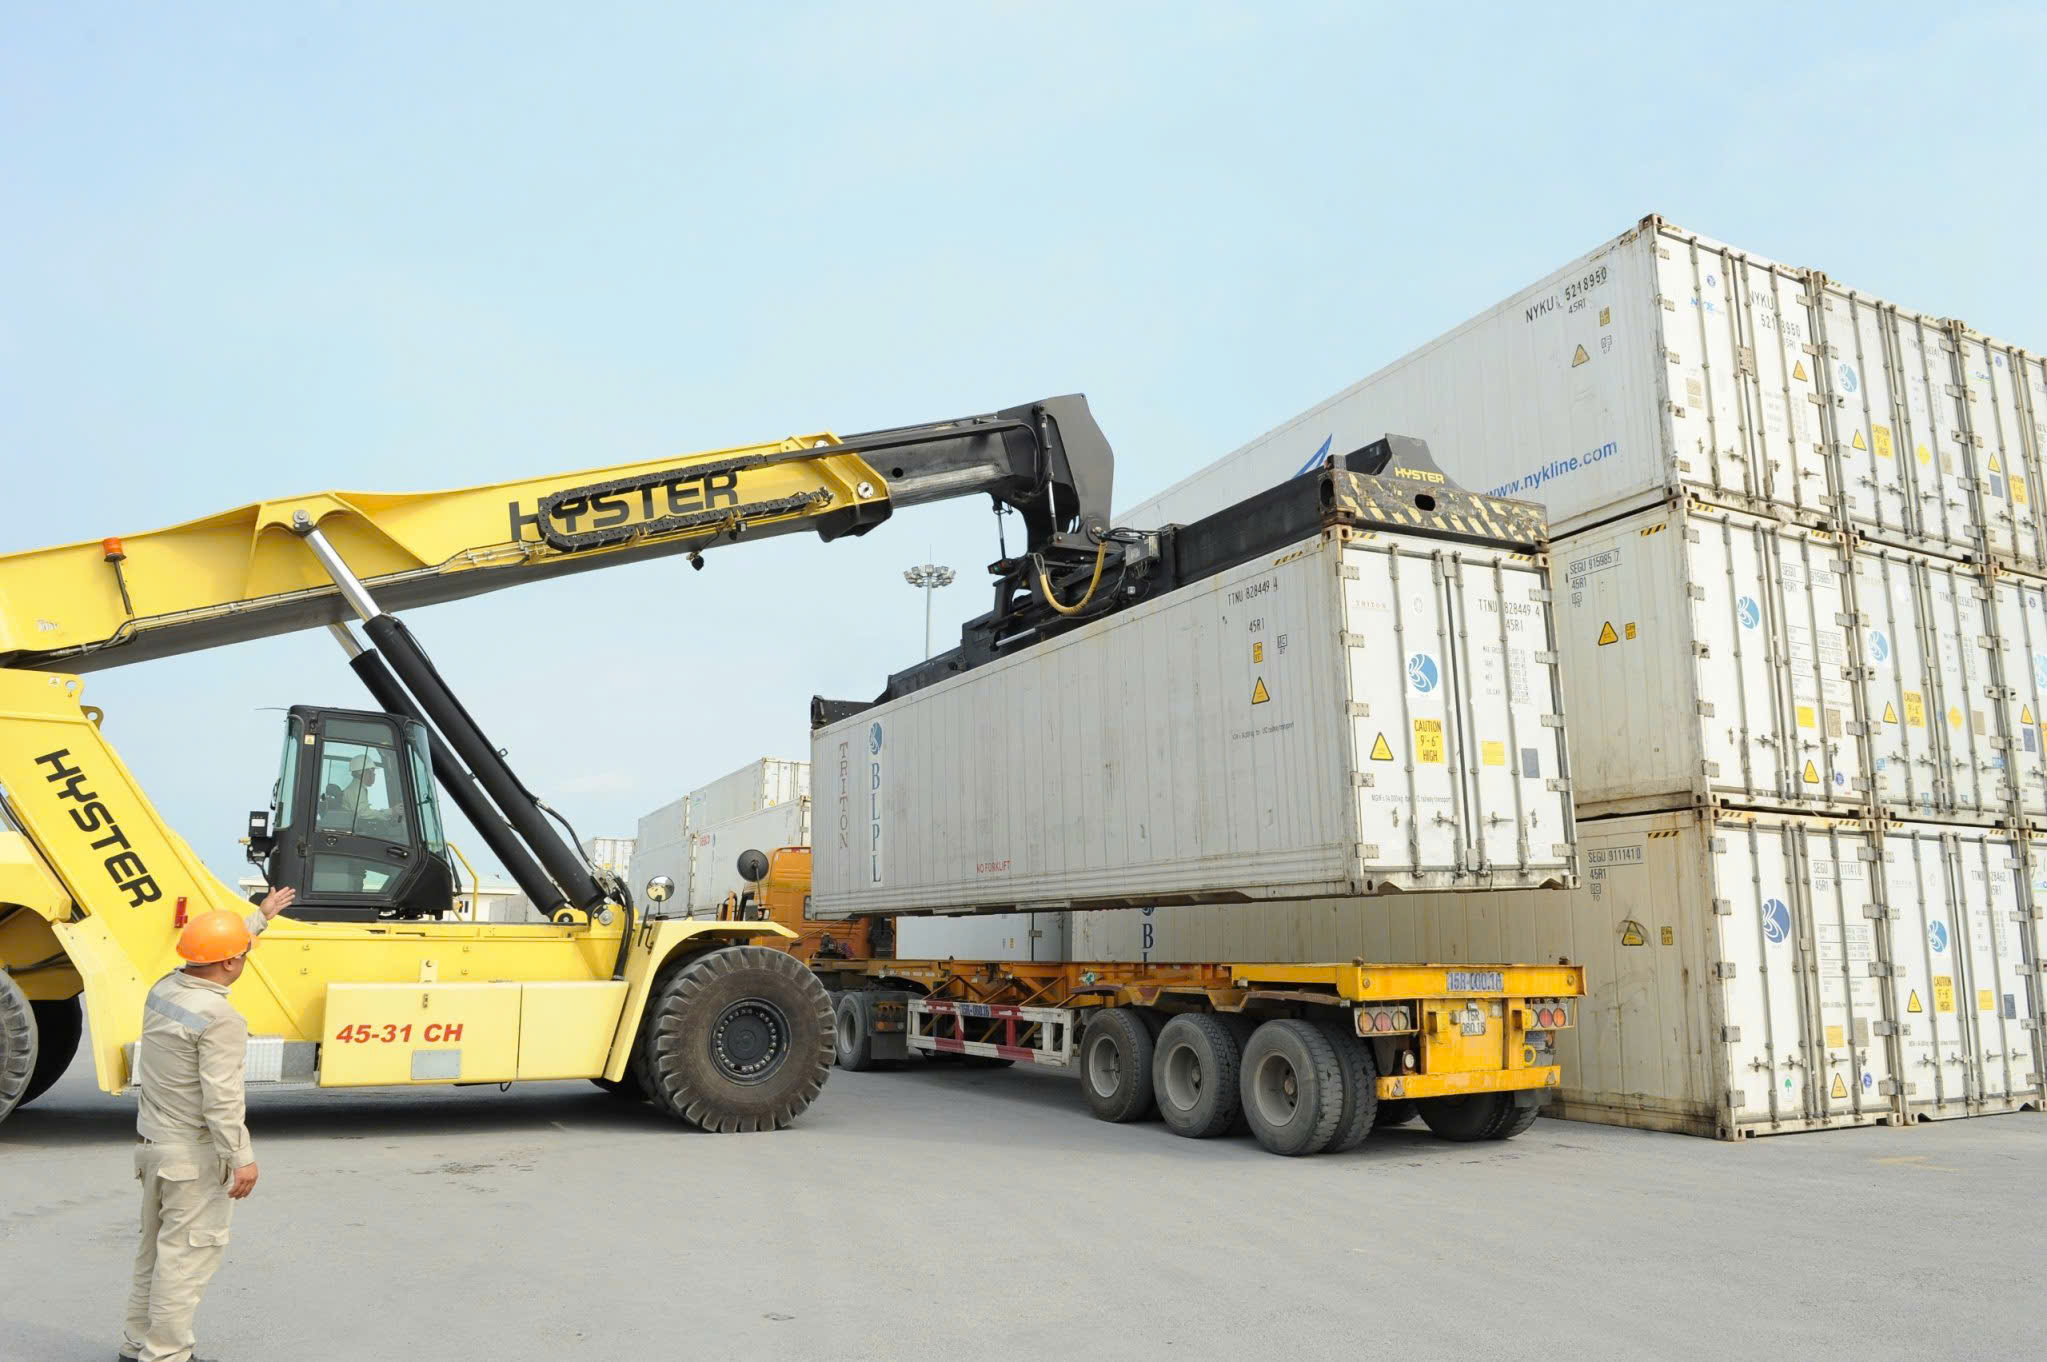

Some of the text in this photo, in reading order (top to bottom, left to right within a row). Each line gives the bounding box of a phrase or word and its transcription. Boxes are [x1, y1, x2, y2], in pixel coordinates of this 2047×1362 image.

[1525, 266, 1607, 323] NYKU 5218950
[1394, 466, 1445, 485] HYSTER
[508, 470, 739, 541] HYSTER
[1569, 561, 1587, 575] SEGU
[1227, 590, 1244, 607] TTNU
[1245, 580, 1270, 600] 828449
[1478, 598, 1498, 614] TTNU
[1504, 601, 1531, 617] 828449
[1248, 616, 1265, 633] 45R1
[1505, 618, 1524, 633] 45R1
[1414, 719, 1442, 733] CAUTION
[839, 741, 849, 849] TRITON
[34, 748, 163, 908] HYSTER
[871, 762, 882, 883] BLPL
[1588, 851, 1607, 864] SEGU
[1608, 848, 1635, 862] 911141
[976, 859, 1012, 874] NO FORKLIFT
[1589, 867, 1607, 881] 45R1
[1812, 862, 1829, 875] SEGU
[1934, 976, 1952, 987] CAUTION
[336, 1023, 463, 1043] 45-31 CH
